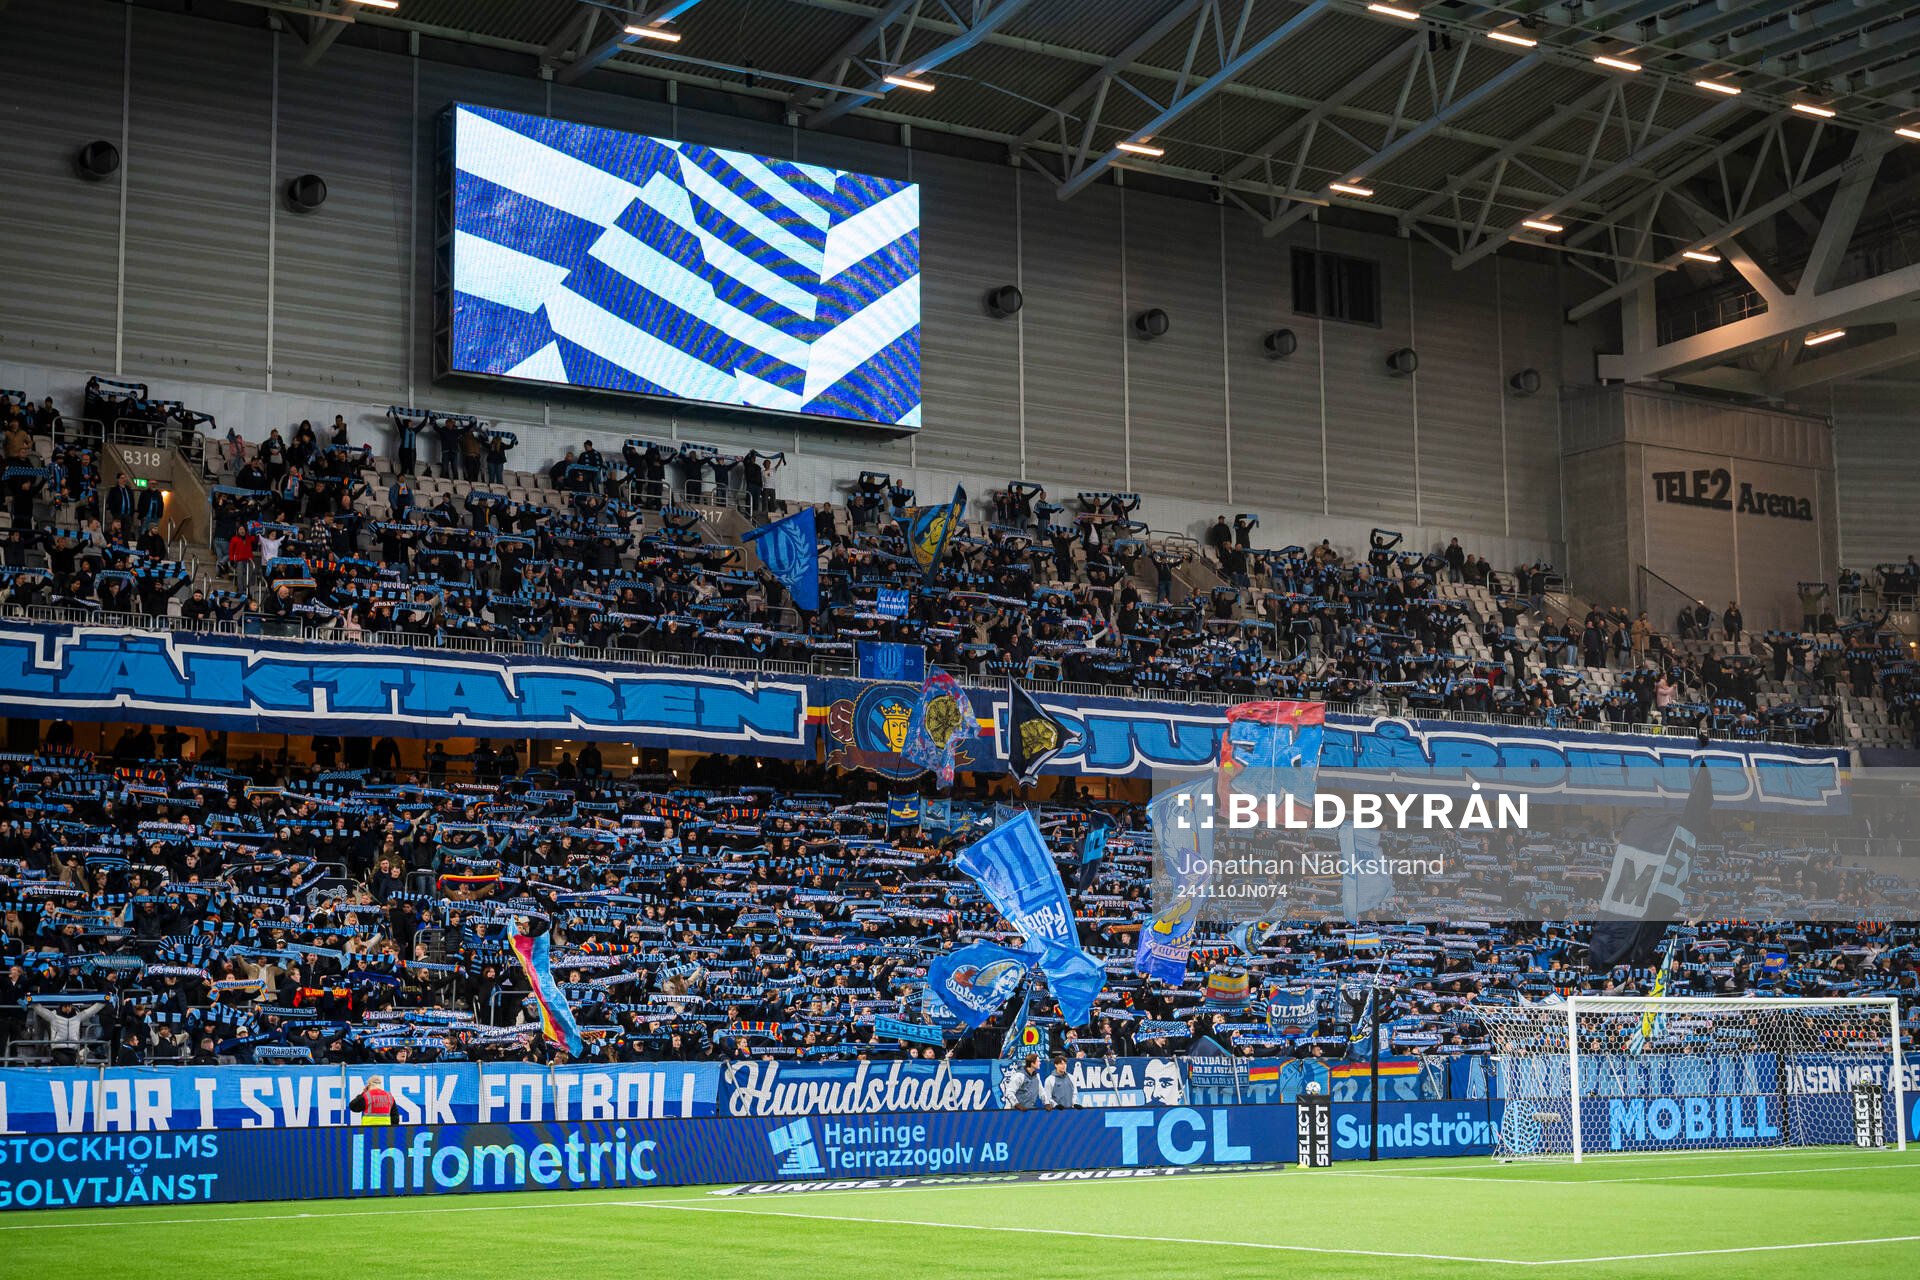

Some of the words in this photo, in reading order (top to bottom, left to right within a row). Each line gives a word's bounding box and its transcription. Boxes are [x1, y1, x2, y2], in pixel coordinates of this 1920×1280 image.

[123, 450, 161, 467] B318
[1652, 468, 1732, 510] TELE2
[1737, 483, 1813, 521] Arena
[696, 508, 723, 523] 317
[1891, 614, 1911, 625] 314
[1271, 1000, 1316, 1018] ULTRAS
[728, 1060, 992, 1117] Huvudstaden
[1073, 1062, 1137, 1089] ÅNGA
[49, 1078, 172, 1133] VAR
[195, 1077, 218, 1130] I
[1080, 1093, 1138, 1107] ATAN
[824, 1121, 926, 1148] Haninge
[1104, 1107, 1251, 1165] TCL
[1297, 1104, 1311, 1167] SELECT
[1315, 1103, 1329, 1167] SELECT
[1336, 1112, 1499, 1149] Sundström
[1609, 1096, 1778, 1150] MOBILL
[1855, 1092, 1871, 1147] SELECT
[0, 1134, 218, 1165] STOCKHOLMS
[352, 1127, 657, 1190] Infometric
[826, 1143, 973, 1171] Terrazzogolv
[980, 1142, 1009, 1162] AB
[0, 1164, 218, 1207] GOLVTJÄNST
[748, 1178, 917, 1193] UNIBET
[1037, 1167, 1188, 1180] UNIBET
